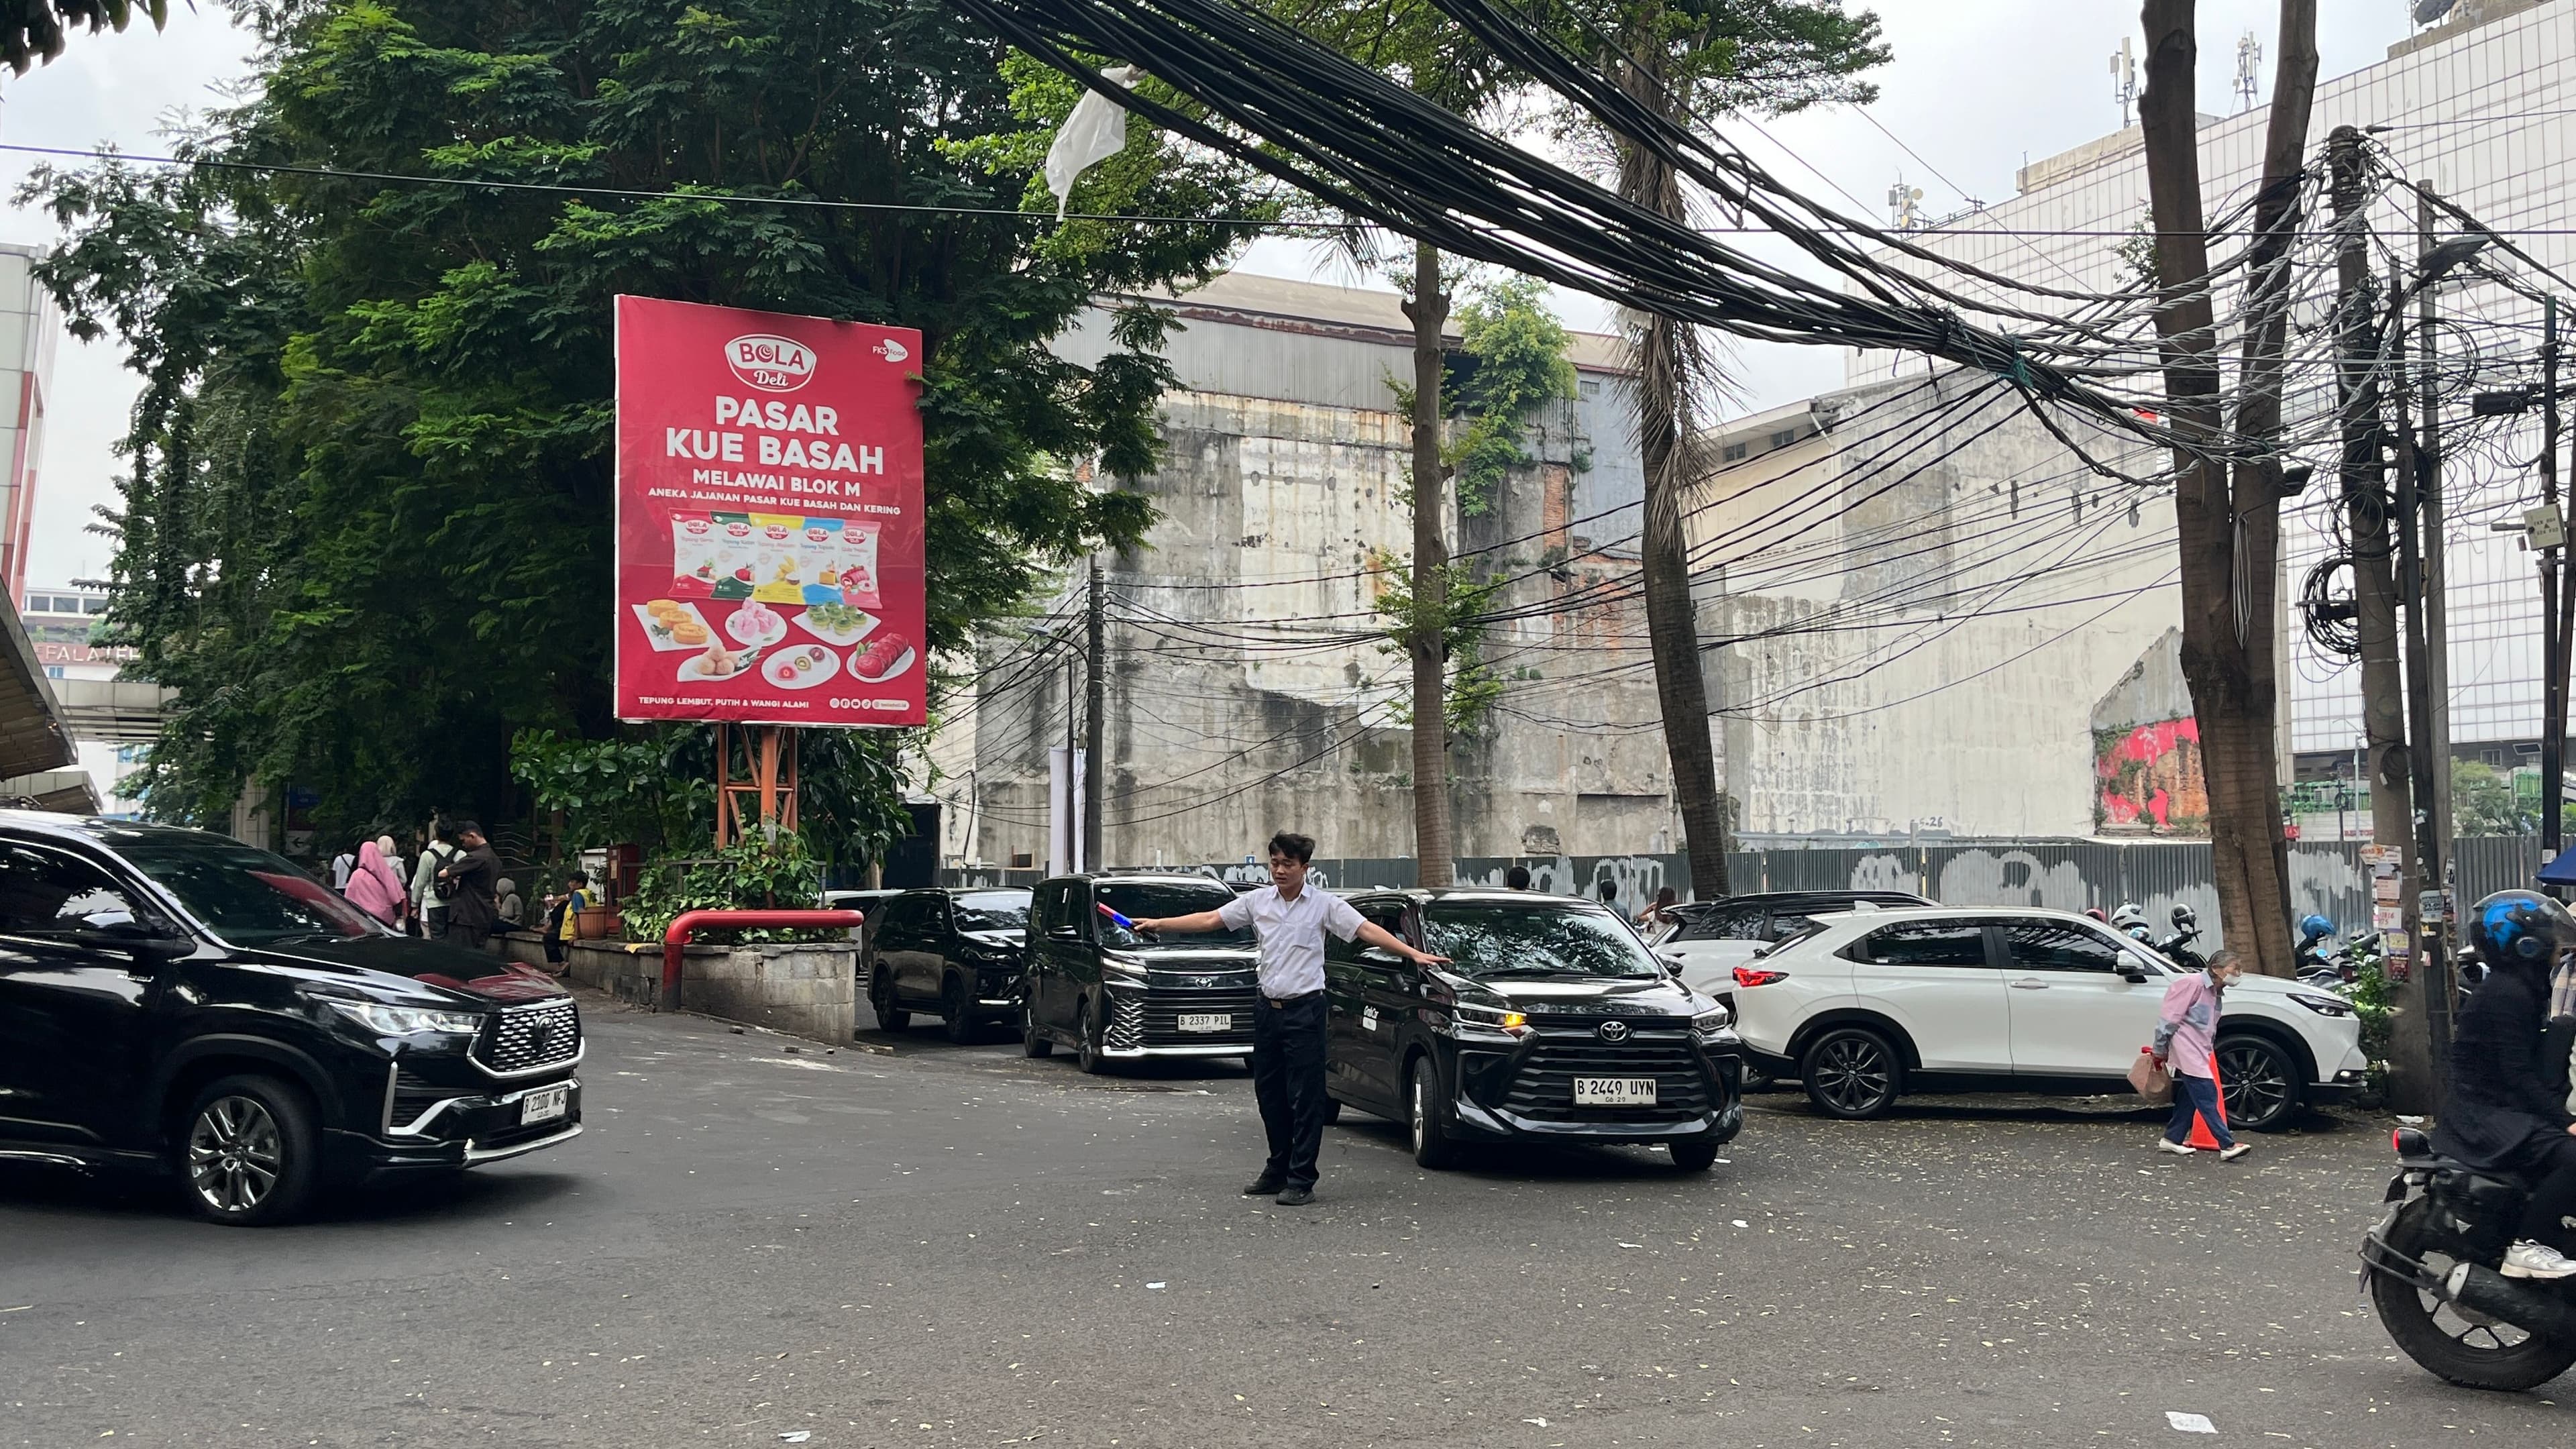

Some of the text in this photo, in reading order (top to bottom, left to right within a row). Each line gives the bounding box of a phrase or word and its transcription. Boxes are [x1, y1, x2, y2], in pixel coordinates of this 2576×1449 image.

[739, 343, 806, 370] BOLA
[872, 345, 888, 355] FKS
[753, 370, 789, 387] Deli
[716, 395, 839, 435] PASAR
[666, 427, 883, 475] KUE BASAH
[693, 469, 860, 496] MELAWAI BLOK M
[648, 488, 901, 515] ANEKA JAJANAN PASAR KUE BASAH DAN KERING
[639, 696, 674, 704] TEPUNG
[677, 698, 713, 706] LEMBUT,
[782, 700, 809, 708] ALAMI
[1180, 1016, 1229, 1026] B 2337 PIL
[1577, 1080, 1654, 1095] B 2449 UYN
